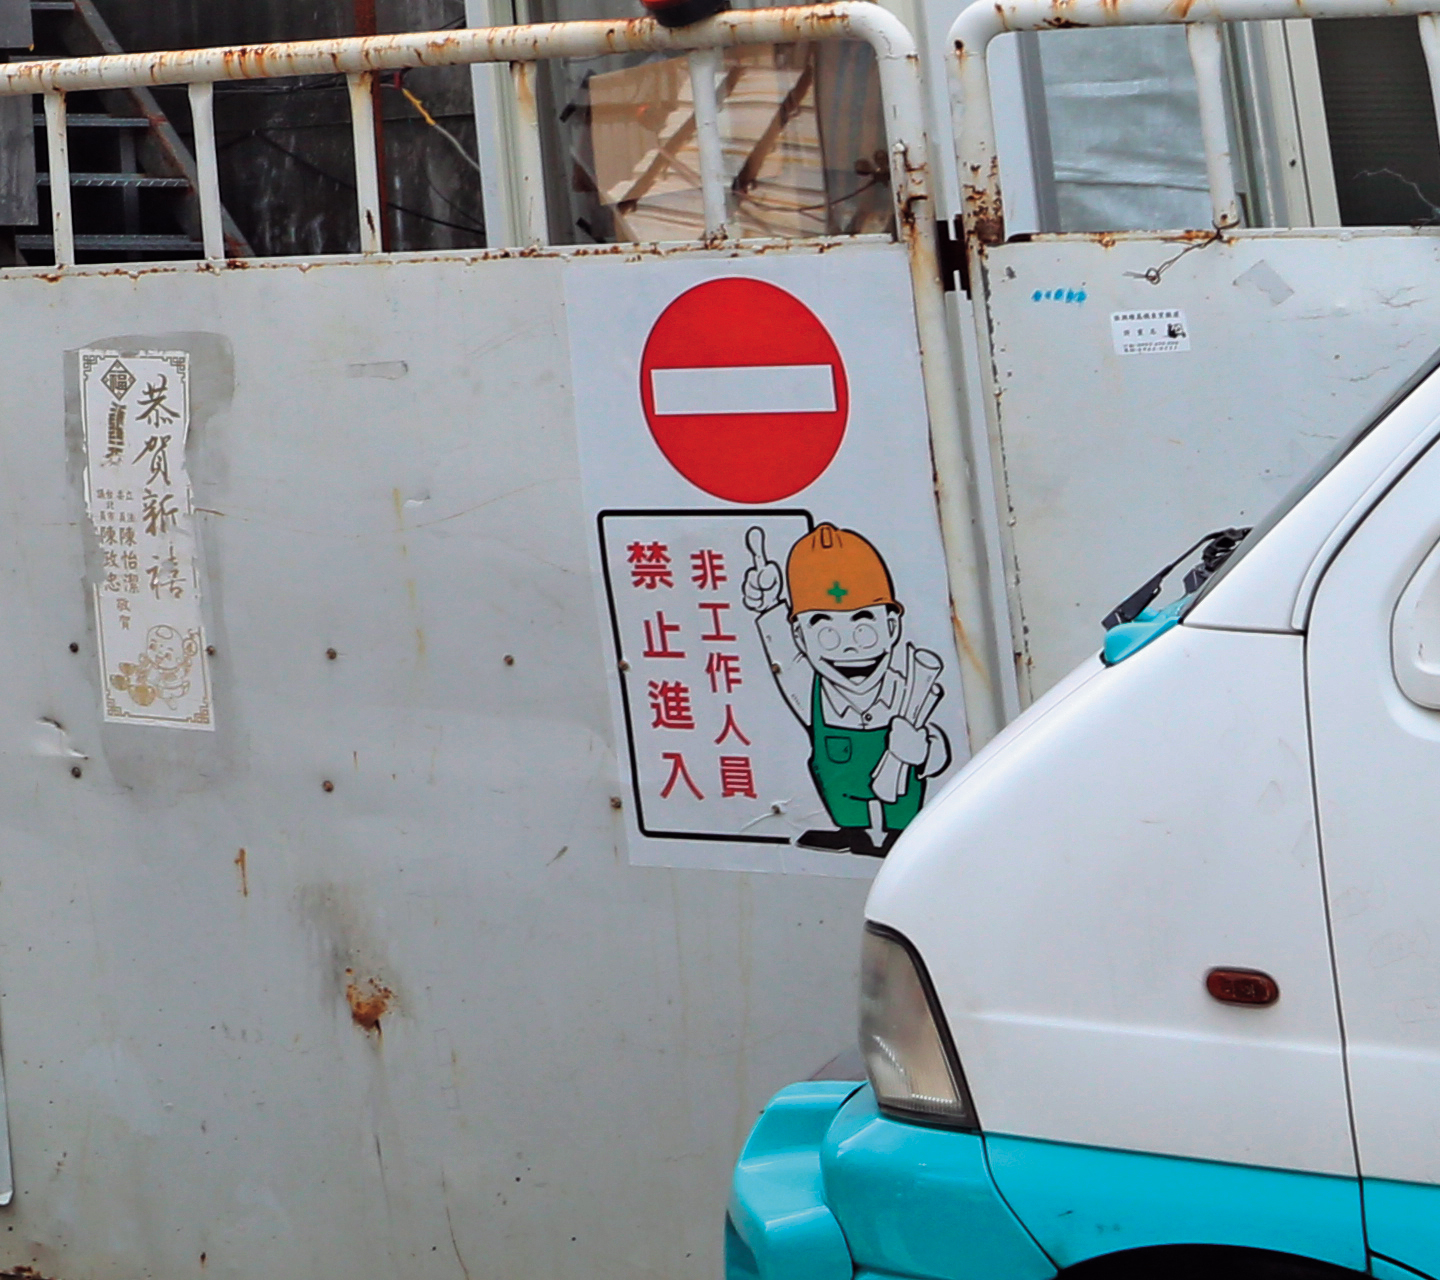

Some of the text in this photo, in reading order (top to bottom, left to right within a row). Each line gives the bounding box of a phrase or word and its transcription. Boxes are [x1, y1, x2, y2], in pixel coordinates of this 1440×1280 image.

[626, 541, 705, 800] 禁止進入
[691, 550, 758, 799] 非工作人員
